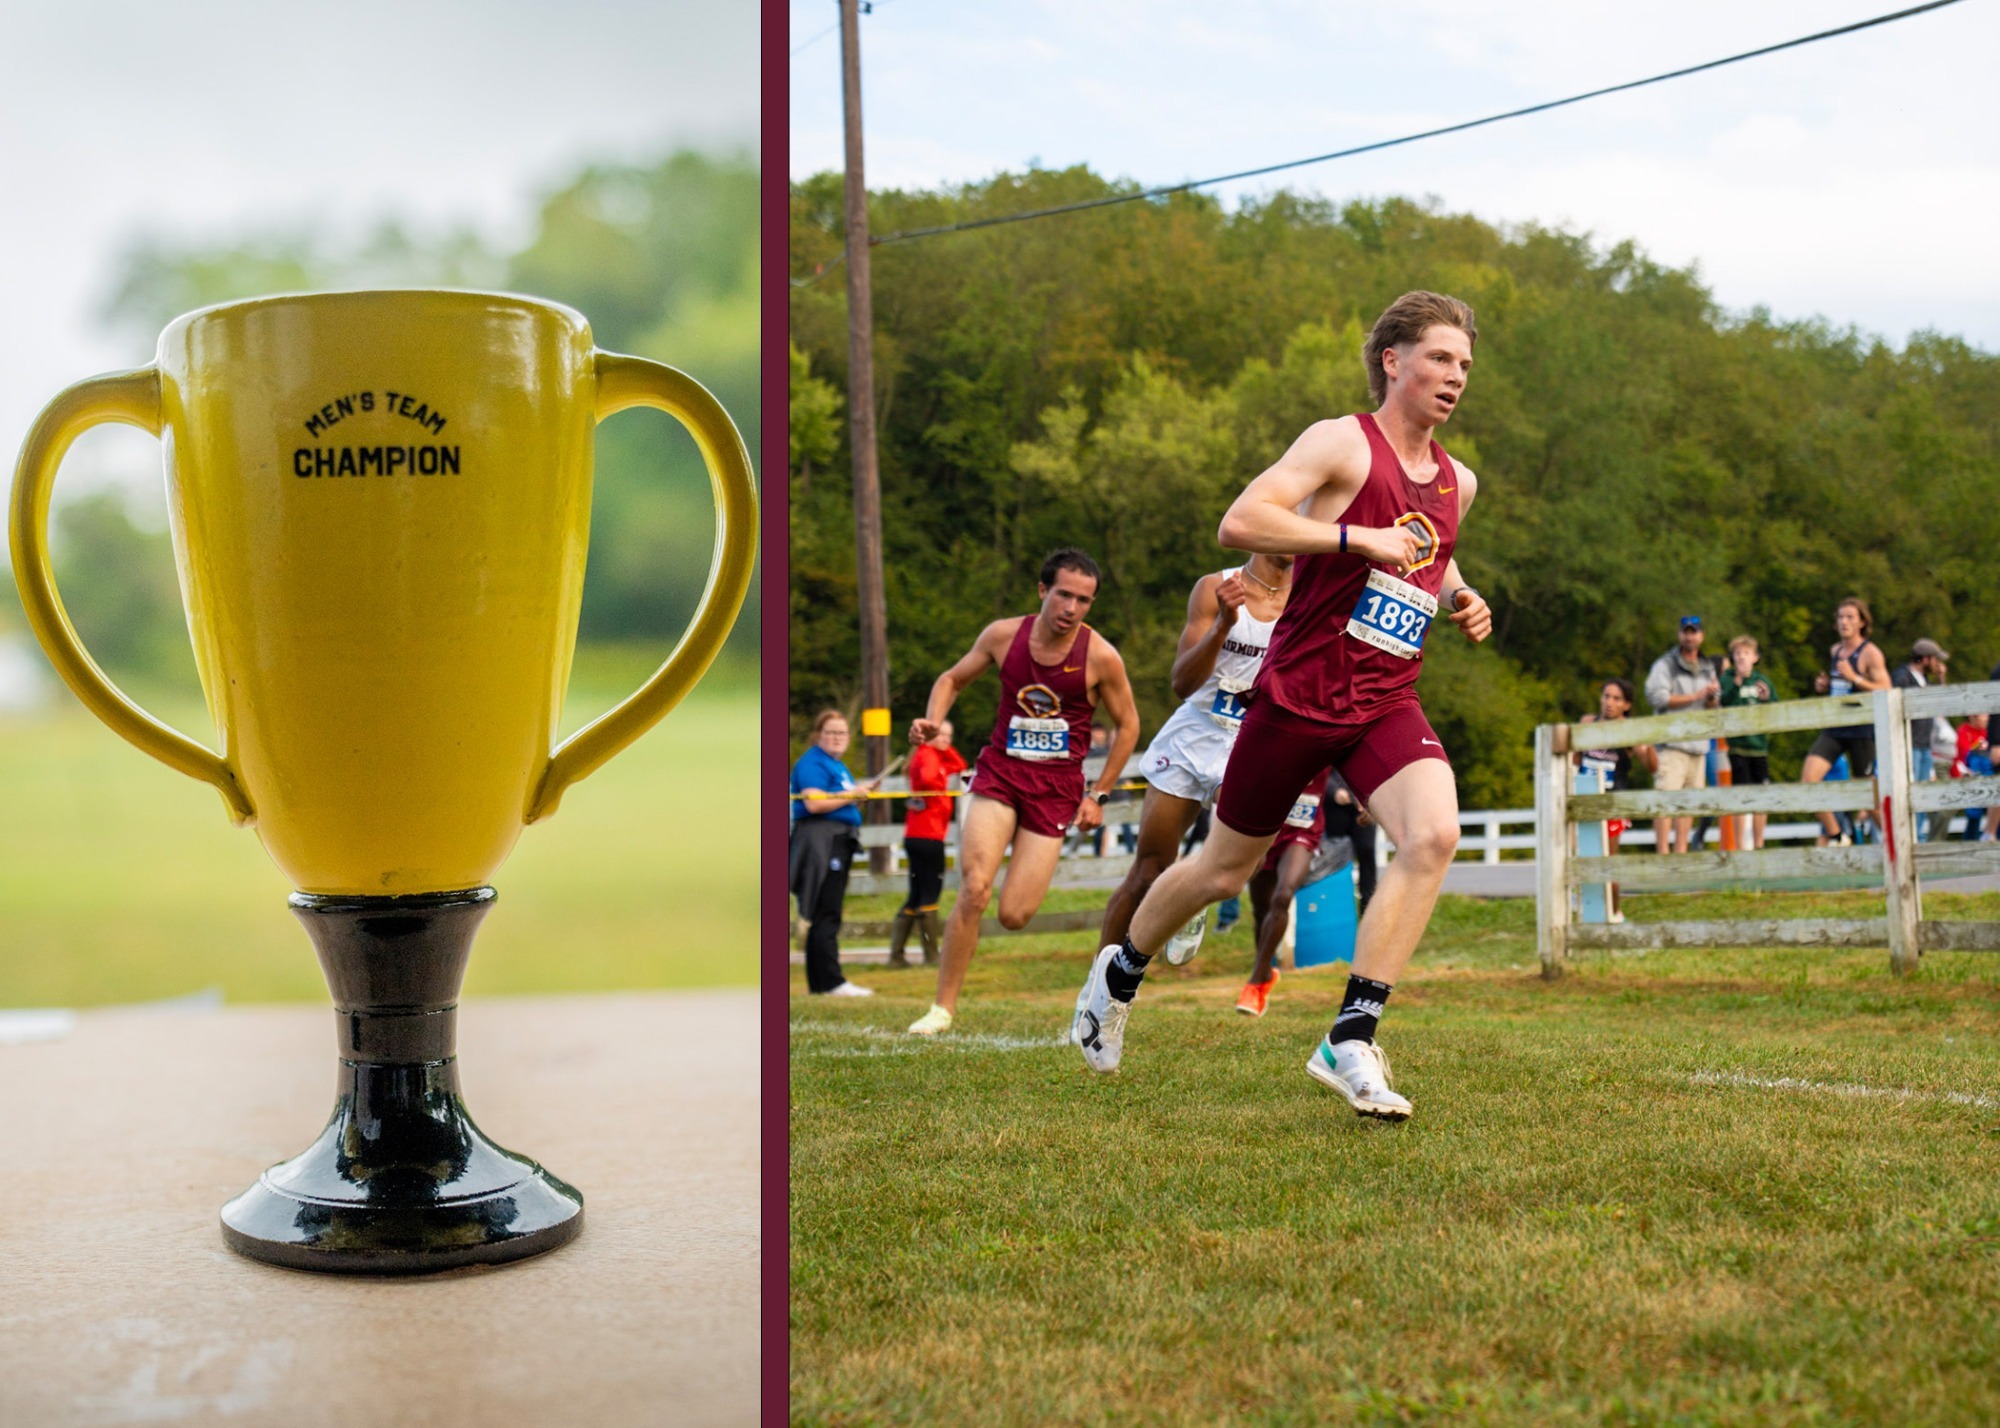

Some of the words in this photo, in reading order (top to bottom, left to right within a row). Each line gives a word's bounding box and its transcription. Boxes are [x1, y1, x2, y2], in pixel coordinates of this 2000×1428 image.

[305, 391, 375, 438] MEN'S
[386, 391, 447, 436] TEAM
[294, 446, 460, 478] CHAMPION
[1361, 595, 1427, 642] 1893
[1012, 730, 1064, 751] 1885
